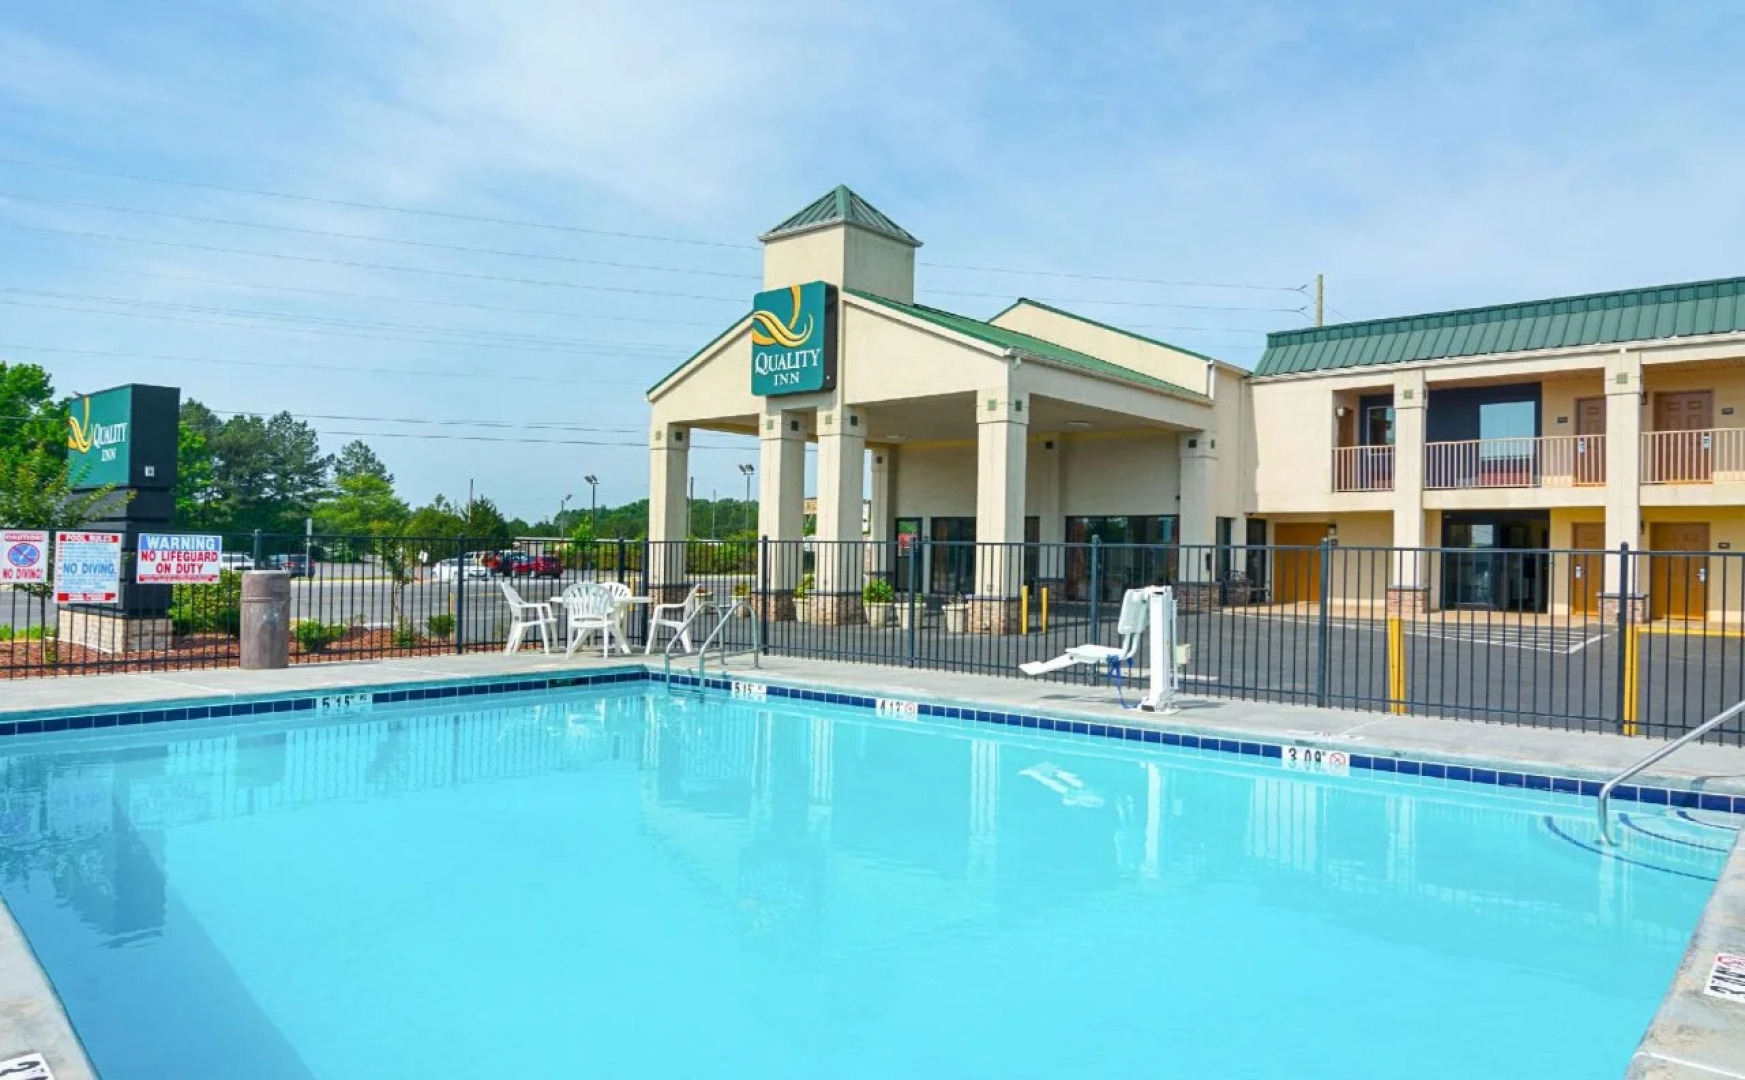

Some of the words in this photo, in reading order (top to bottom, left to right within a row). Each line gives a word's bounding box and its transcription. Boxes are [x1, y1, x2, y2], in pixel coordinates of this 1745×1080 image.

[755, 349, 821, 375] QUALITY
[773, 371, 800, 386] INN
[93, 422, 128, 450] QUALITY
[101, 447, 117, 462] INN
[147, 536, 215, 551] WARNING
[141, 550, 156, 562] NO
[161, 551, 219, 562] LIFEGUARD
[2, 568, 13, 579] NO
[63, 562, 78, 574] NO
[156, 563, 171, 573] ON
[176, 563, 203, 574] DUTY
